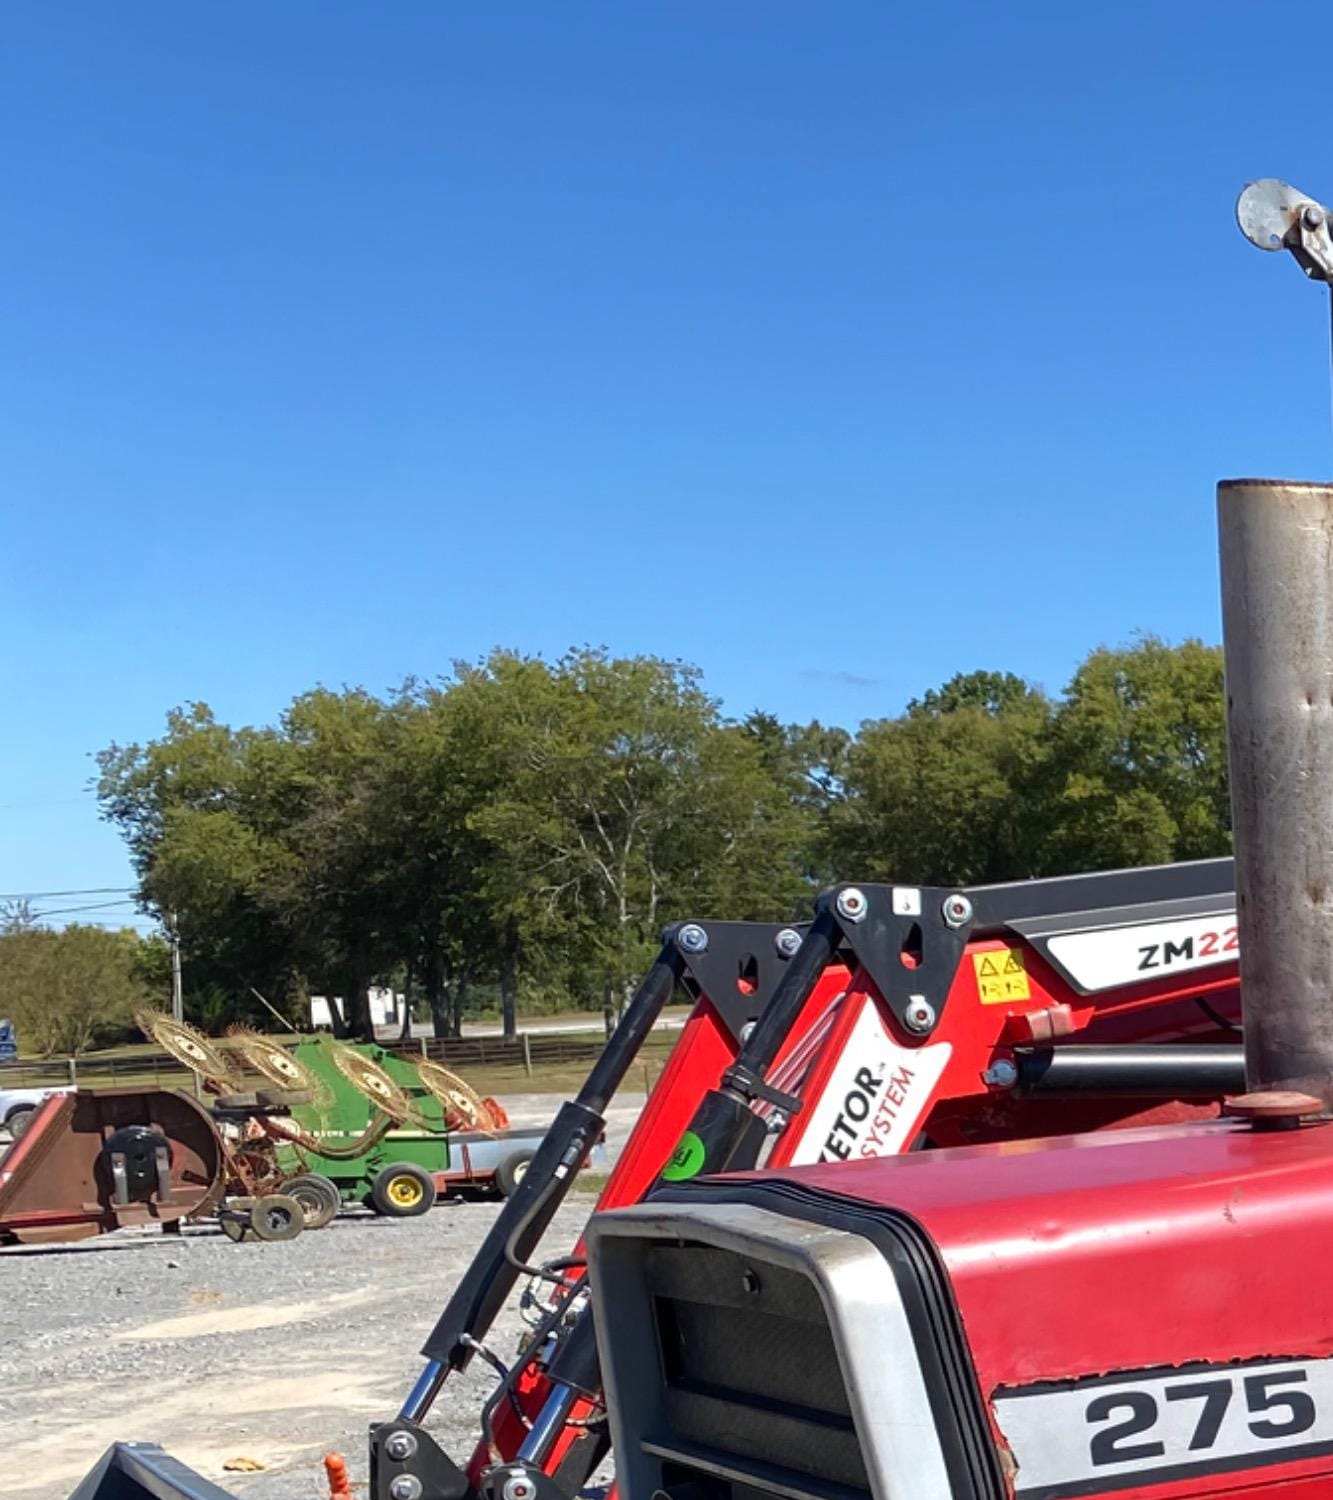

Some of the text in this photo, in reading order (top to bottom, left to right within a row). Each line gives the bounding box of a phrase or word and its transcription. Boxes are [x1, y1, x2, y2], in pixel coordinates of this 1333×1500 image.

[818, 1066, 883, 1162] ETOR
[860, 1065, 915, 1158] SYSTEM
[1085, 1369, 1317, 1467] 275
